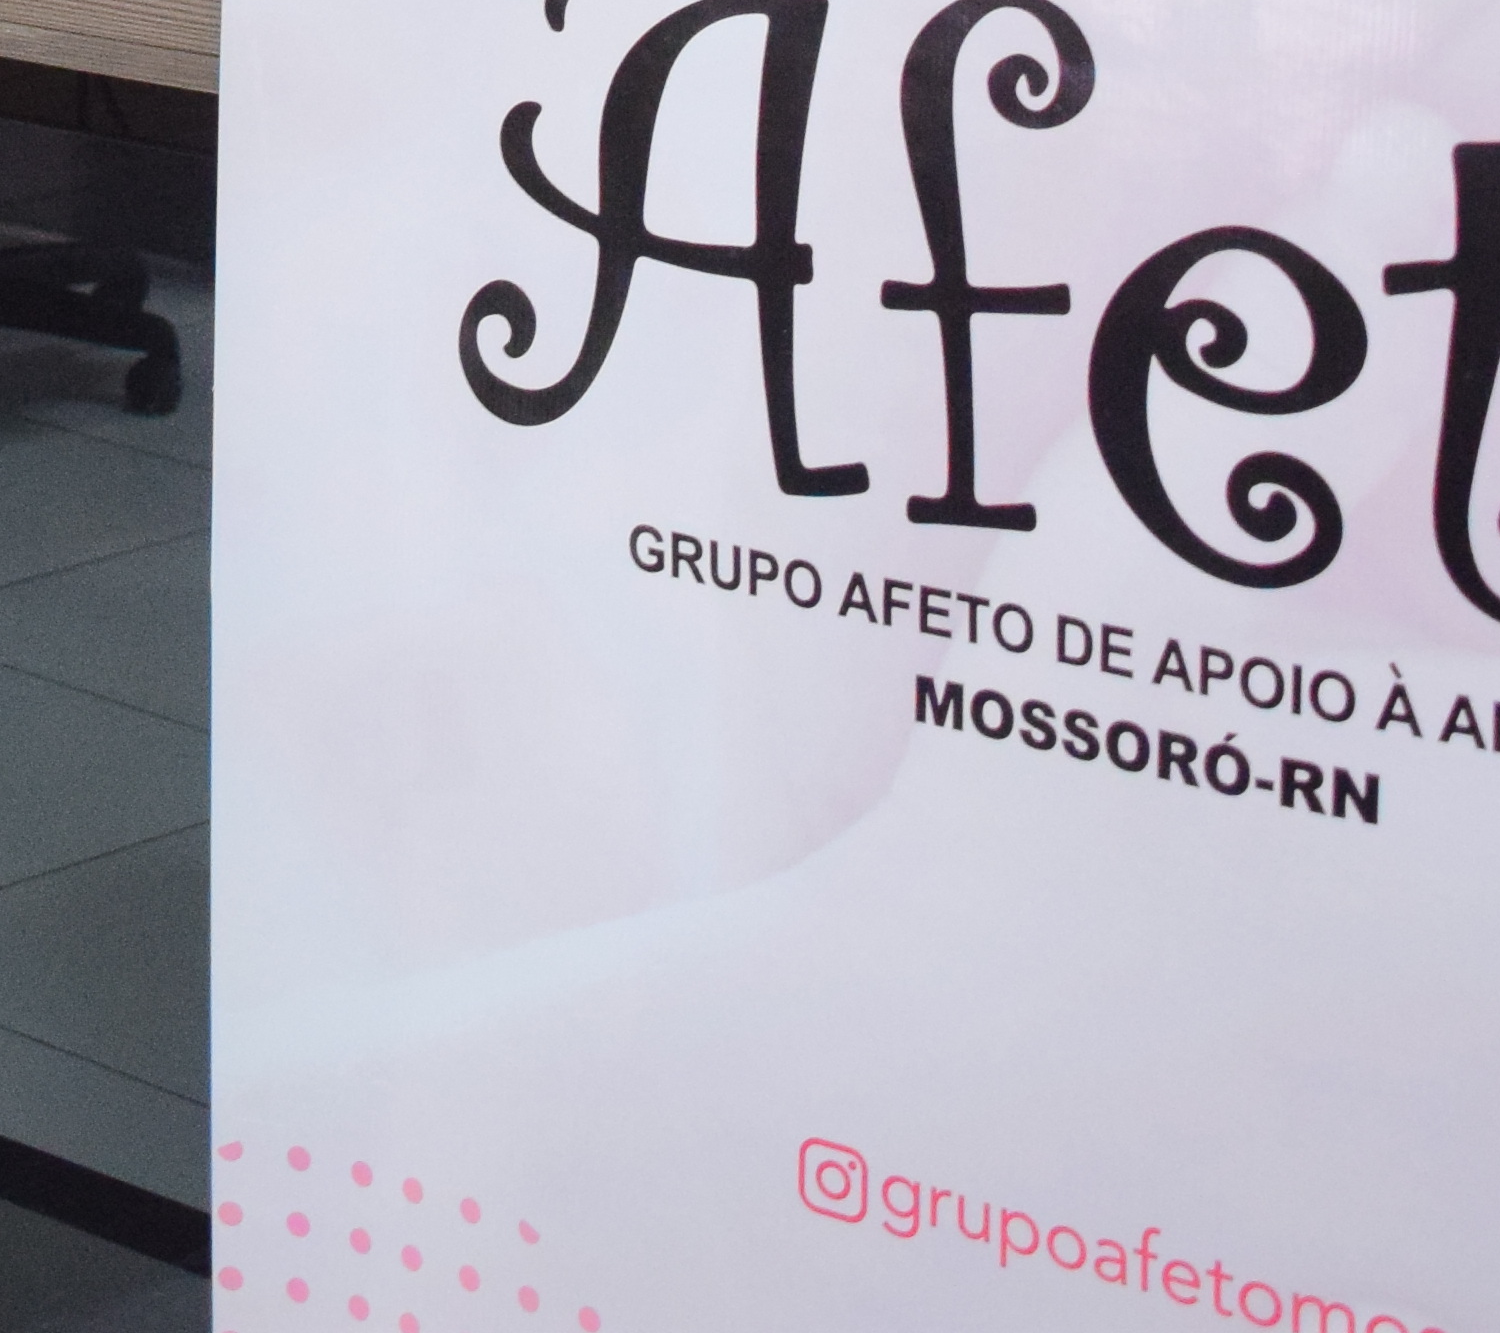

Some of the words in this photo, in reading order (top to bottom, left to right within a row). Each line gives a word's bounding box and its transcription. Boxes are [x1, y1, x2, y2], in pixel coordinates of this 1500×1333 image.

[628, 523, 824, 610] GRUPO
[837, 571, 1036, 655] AFETO
[1055, 614, 1135, 678] DE
[1151, 637, 1358, 724] APOIO
[1374, 661, 1424, 739] À
[913, 674, 1382, 826] MOSSORÓ-RN
